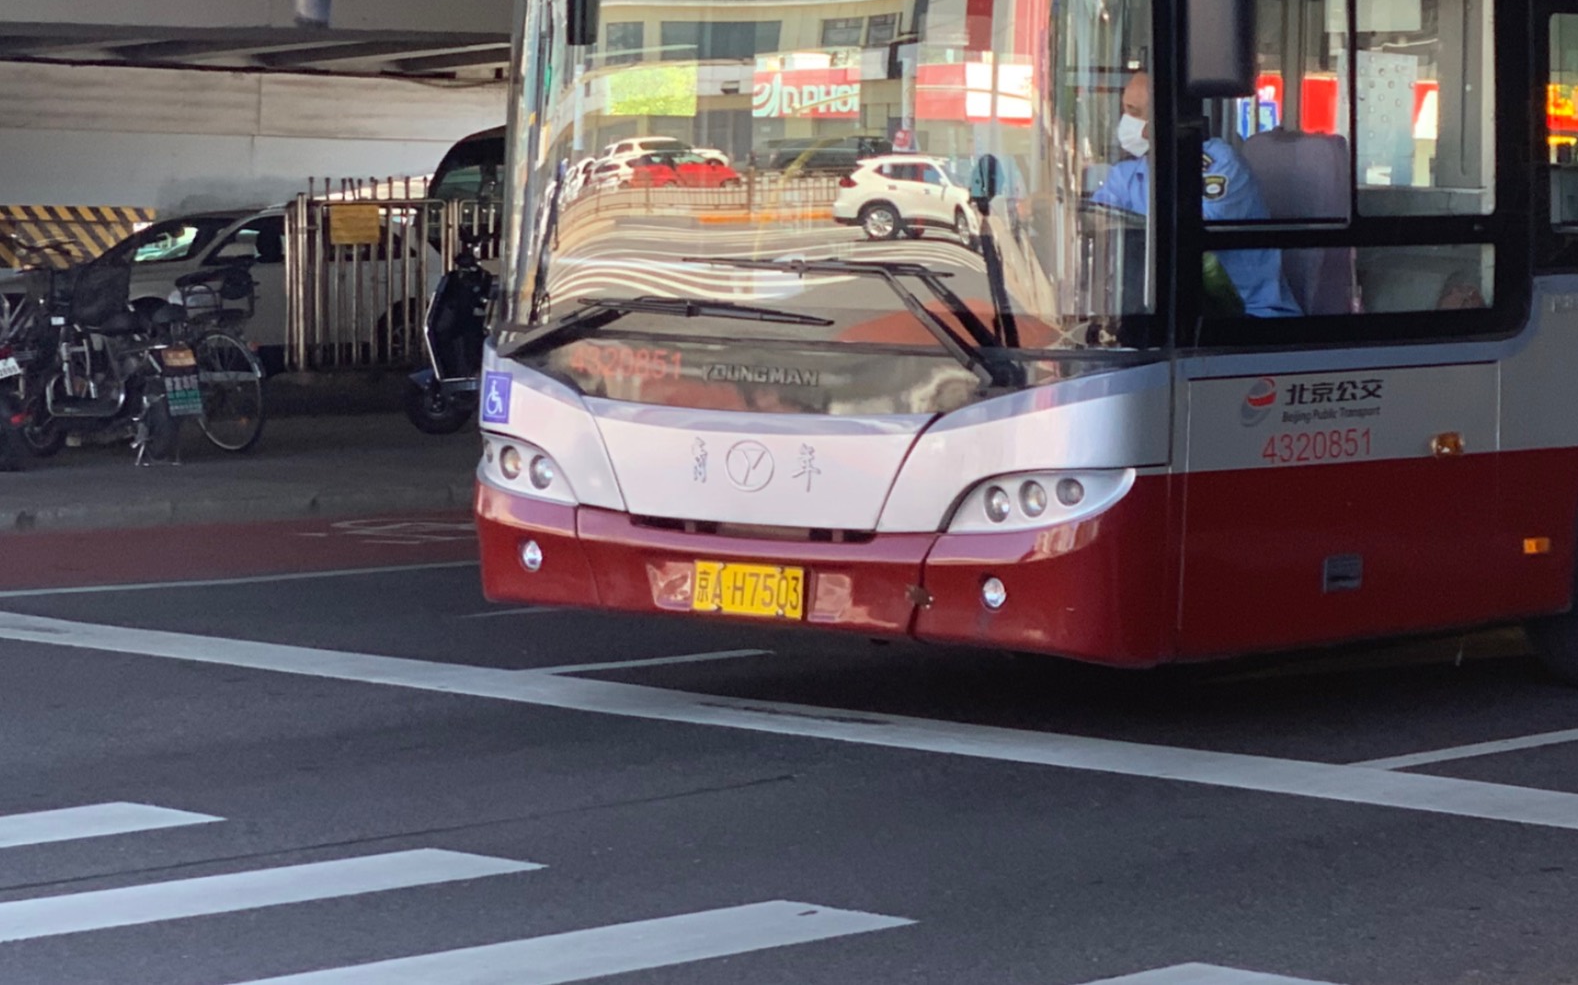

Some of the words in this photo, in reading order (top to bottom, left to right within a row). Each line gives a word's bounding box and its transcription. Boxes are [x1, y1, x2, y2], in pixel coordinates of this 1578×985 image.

[569, 345, 684, 381] 4320851
[701, 364, 820, 388] YOUNGMAN
[1284, 378, 1385, 406] 北京公交
[1282, 411, 1312, 424] Beijing
[1313, 407, 1337, 420] Public
[1340, 406, 1381, 419] Transport
[1262, 428, 1372, 464] 4320851
